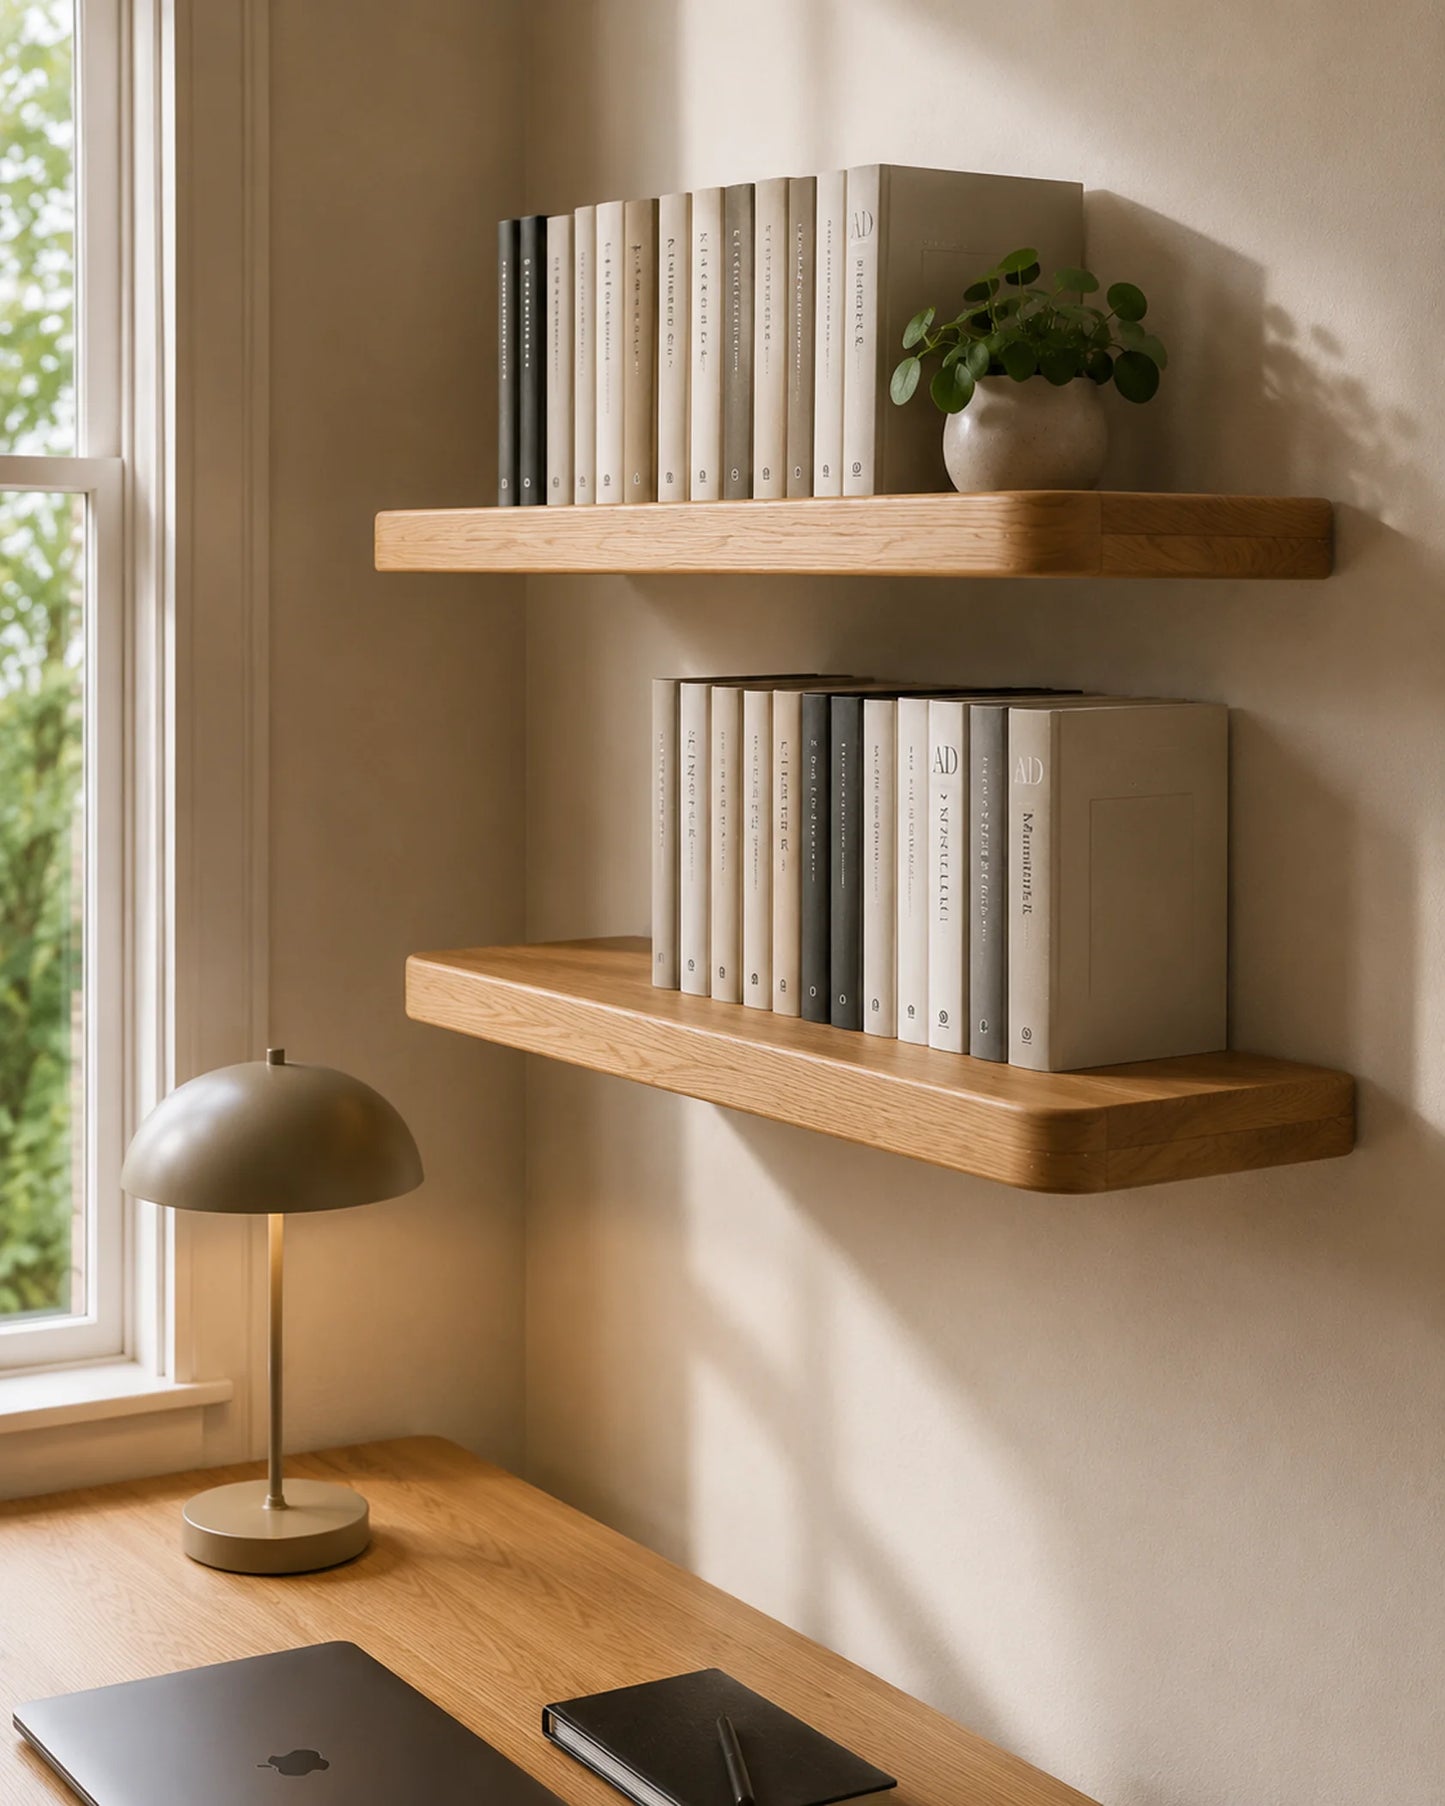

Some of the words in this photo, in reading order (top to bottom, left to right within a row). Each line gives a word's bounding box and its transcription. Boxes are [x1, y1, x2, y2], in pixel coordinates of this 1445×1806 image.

[850, 210, 874, 239] AD
[932, 745, 959, 775] AD
[1013, 756, 1044, 785] AD
